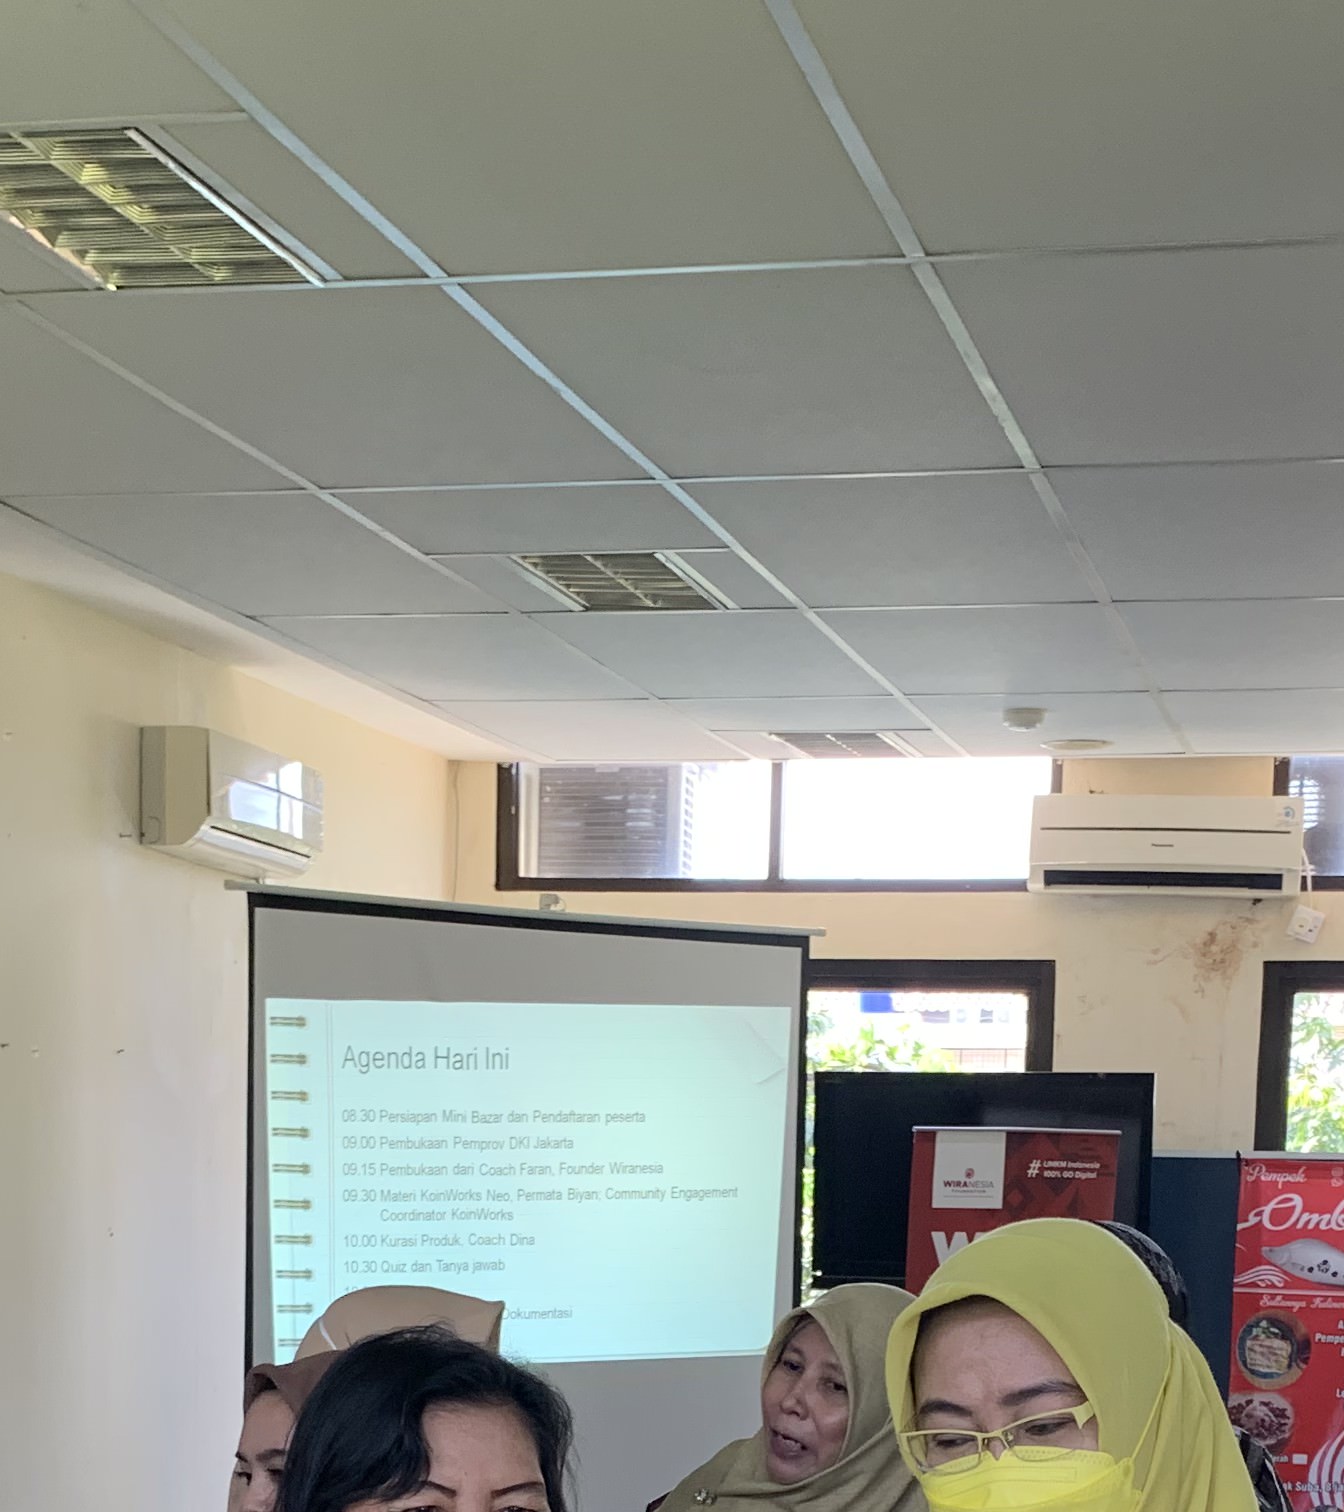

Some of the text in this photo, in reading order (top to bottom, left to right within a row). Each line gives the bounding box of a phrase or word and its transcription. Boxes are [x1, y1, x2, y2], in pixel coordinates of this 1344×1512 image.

[341, 1045, 509, 1074] Agenda Hari Ini
[342, 1109, 646, 1126] 08.30 Persiapan Mini Bazar dan Pendaftaran peserta
[342, 1136, 574, 1153] 09.00 Pembukaan Pemprov DKI Jakarta
[342, 1163, 376, 1176] 09.15
[380, 1162, 448, 1176] Pembukaan
[453, 1162, 475, 1176] dari
[479, 1162, 516, 1176] Coach
[559, 1162, 605, 1175] Founder
[609, 1161, 664, 1174] Wiranesia
[1247, 1164, 1307, 1189] Pempek
[943, 1180, 994, 1189] WIRANESIA
[342, 1189, 376, 1202] 09.30
[380, 1189, 416, 1202] Materi
[420, 1188, 482, 1202] KoinWorks
[517, 1188, 563, 1202] Permata
[605, 1187, 667, 1202] Community
[670, 1186, 738, 1201] Engagement
[380, 1207, 514, 1222] Coordinator KoinWorks
[343, 1235, 377, 1248] 10.00
[381, 1235, 417, 1248] Kurasi
[468, 1233, 505, 1246] Coach
[510, 1233, 535, 1246] Dina
[343, 1258, 505, 1276] 10.30 Quiz dan Tanya jawab
[503, 1308, 573, 1320] Dokumentasi
